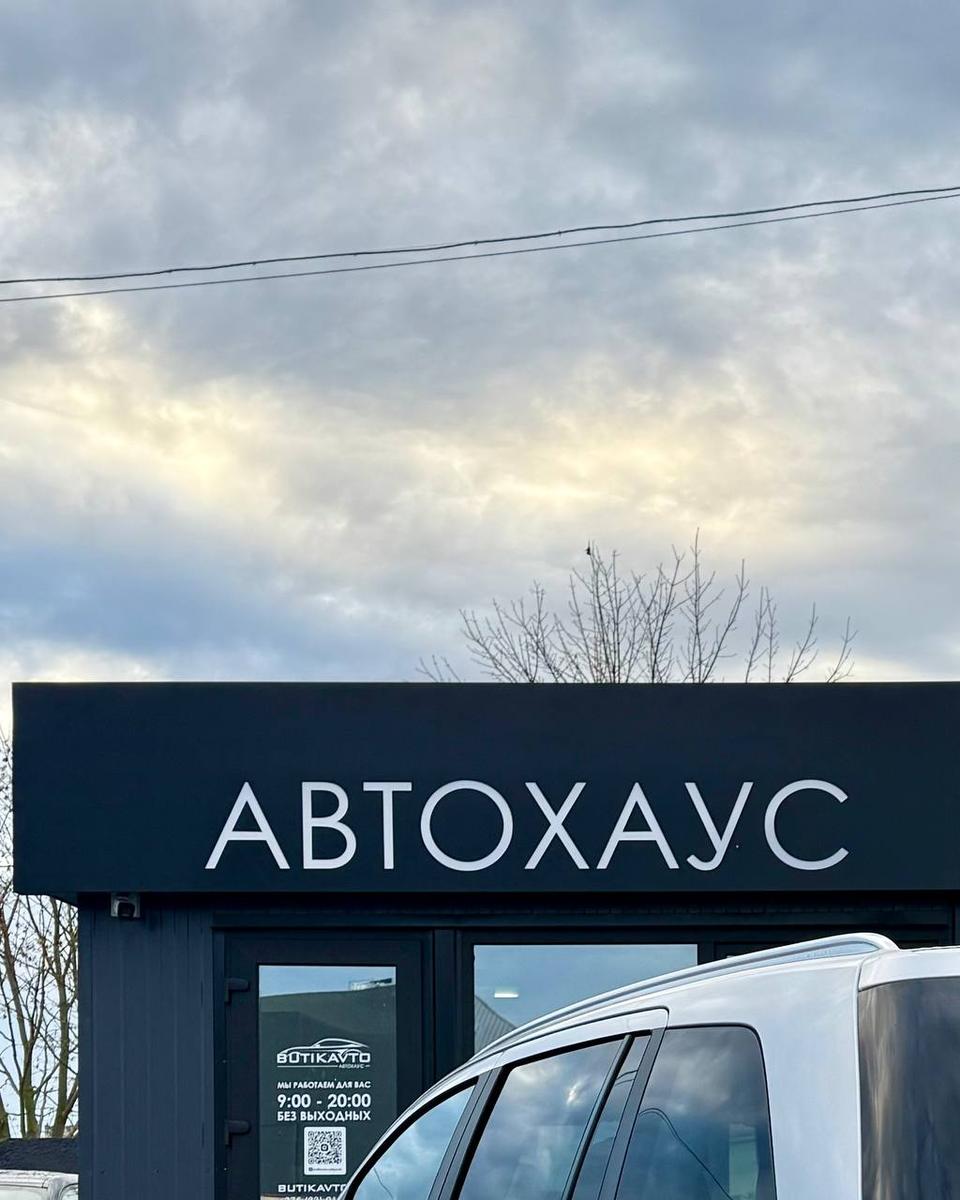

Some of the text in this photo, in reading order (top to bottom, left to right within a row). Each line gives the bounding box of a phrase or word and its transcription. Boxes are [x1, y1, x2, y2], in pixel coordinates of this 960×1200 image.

[205, 779, 850, 872] АВТОХАУС
[276, 1052, 371, 1064] BUTIKAVTO
[277, 1081, 371, 1090] МЫ РАБОТАЕМ ДЛЯ ВАС
[277, 1093, 312, 1109] 9:00
[327, 1093, 372, 1108] 20:00
[277, 1110, 372, 1122] БЕЗ ВЫХОДНЫХ
